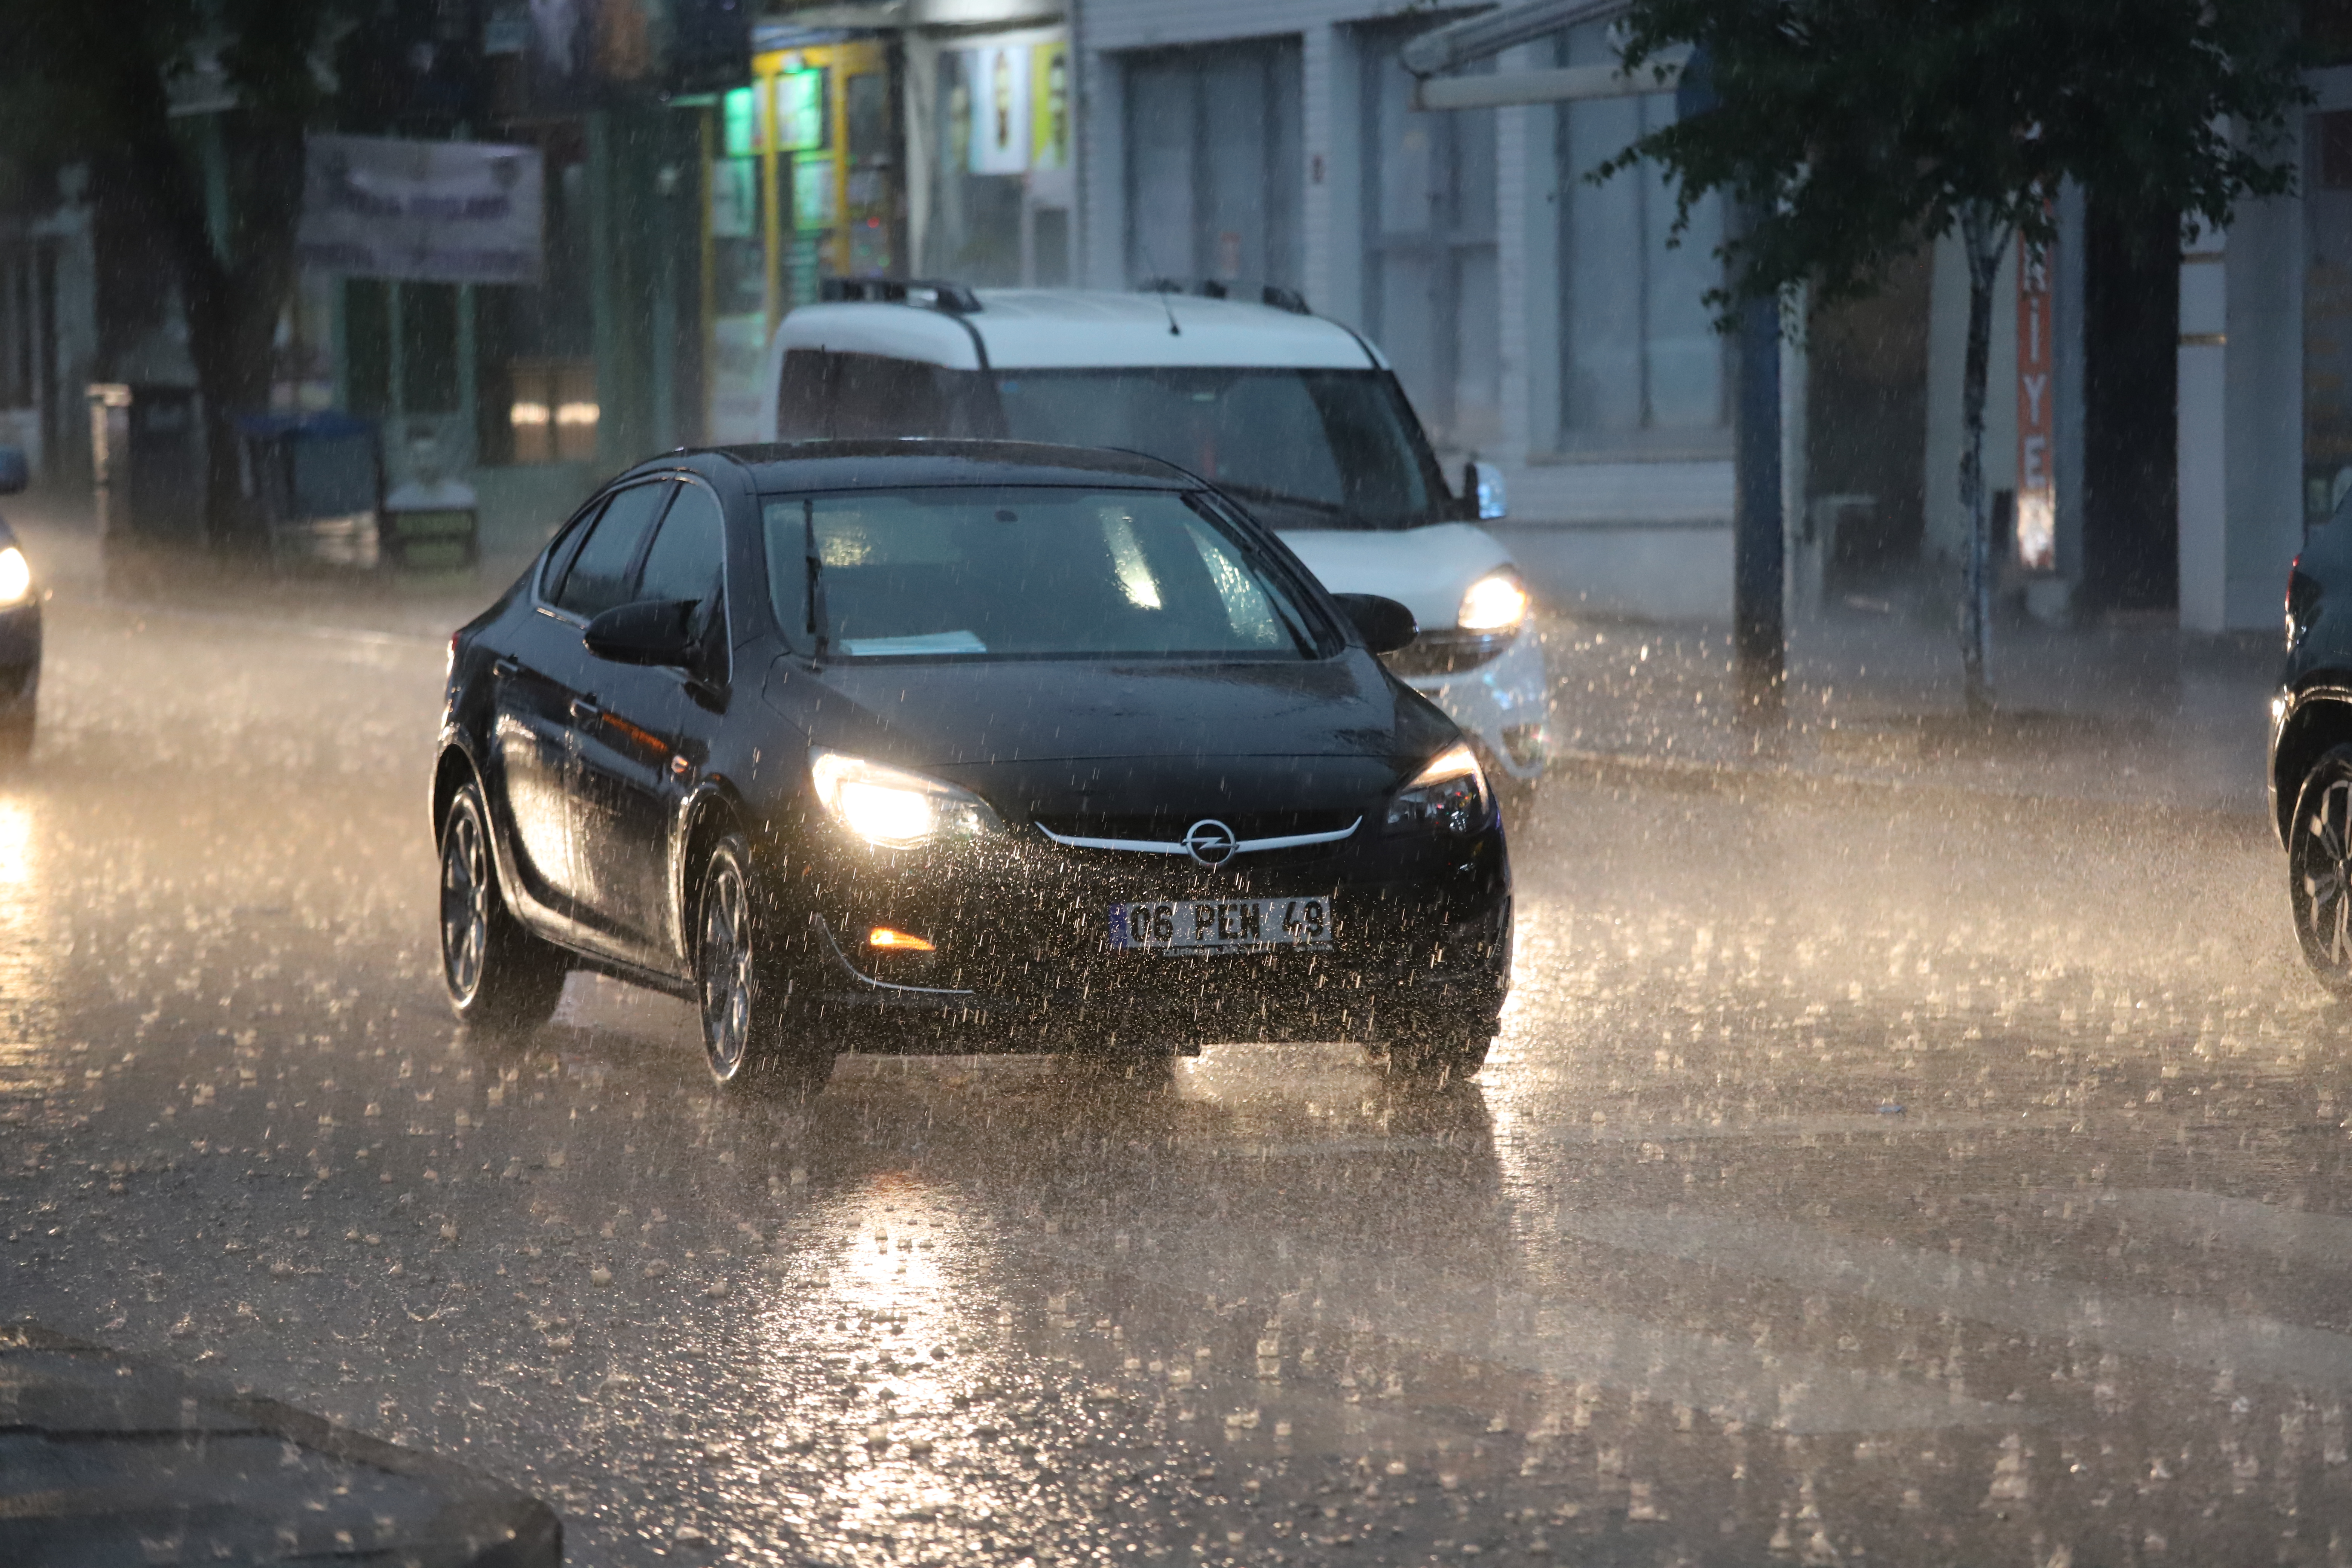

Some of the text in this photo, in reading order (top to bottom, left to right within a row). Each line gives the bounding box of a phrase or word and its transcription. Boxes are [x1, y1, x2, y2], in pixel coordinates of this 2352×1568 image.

[1131, 901, 1323, 942] 06 PEN 49
